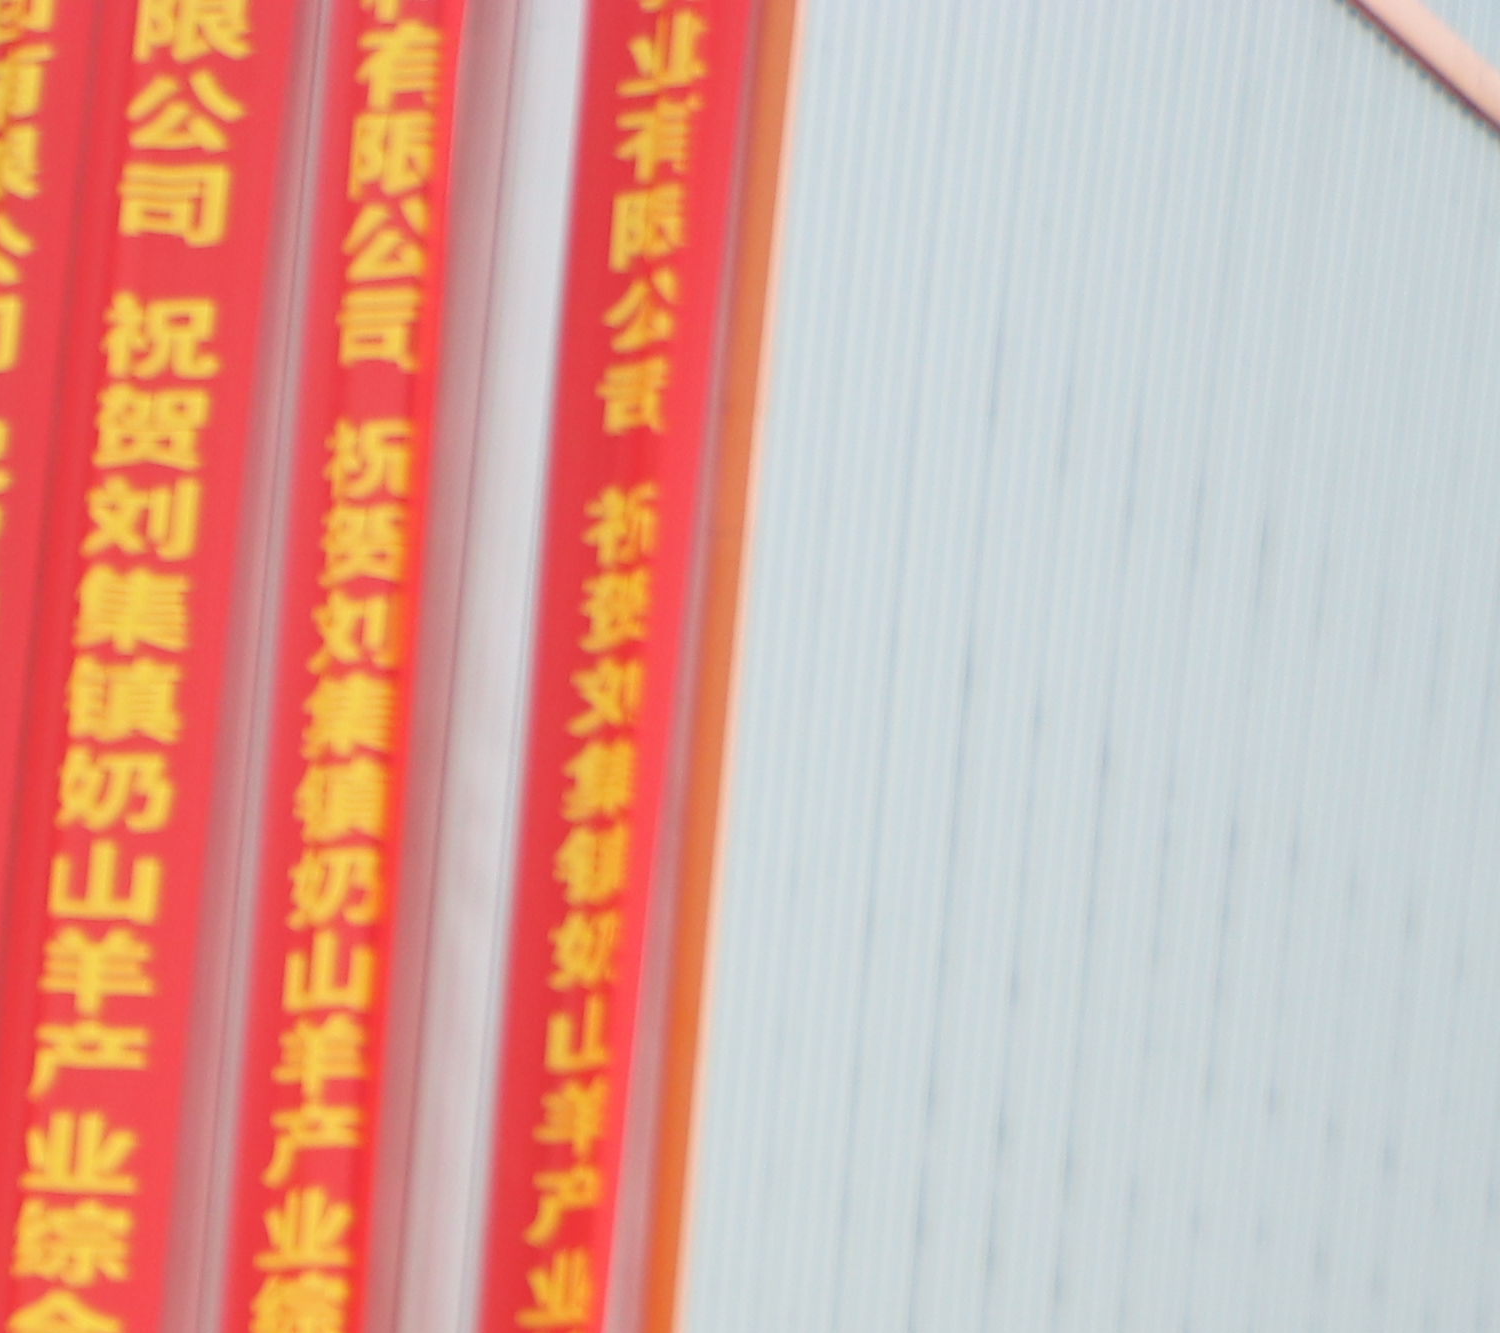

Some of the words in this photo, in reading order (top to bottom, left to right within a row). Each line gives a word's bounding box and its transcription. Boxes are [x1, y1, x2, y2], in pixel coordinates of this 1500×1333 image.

[340, 0, 440, 369] 有限公司
[600, 0, 705, 431] 业有限公司
